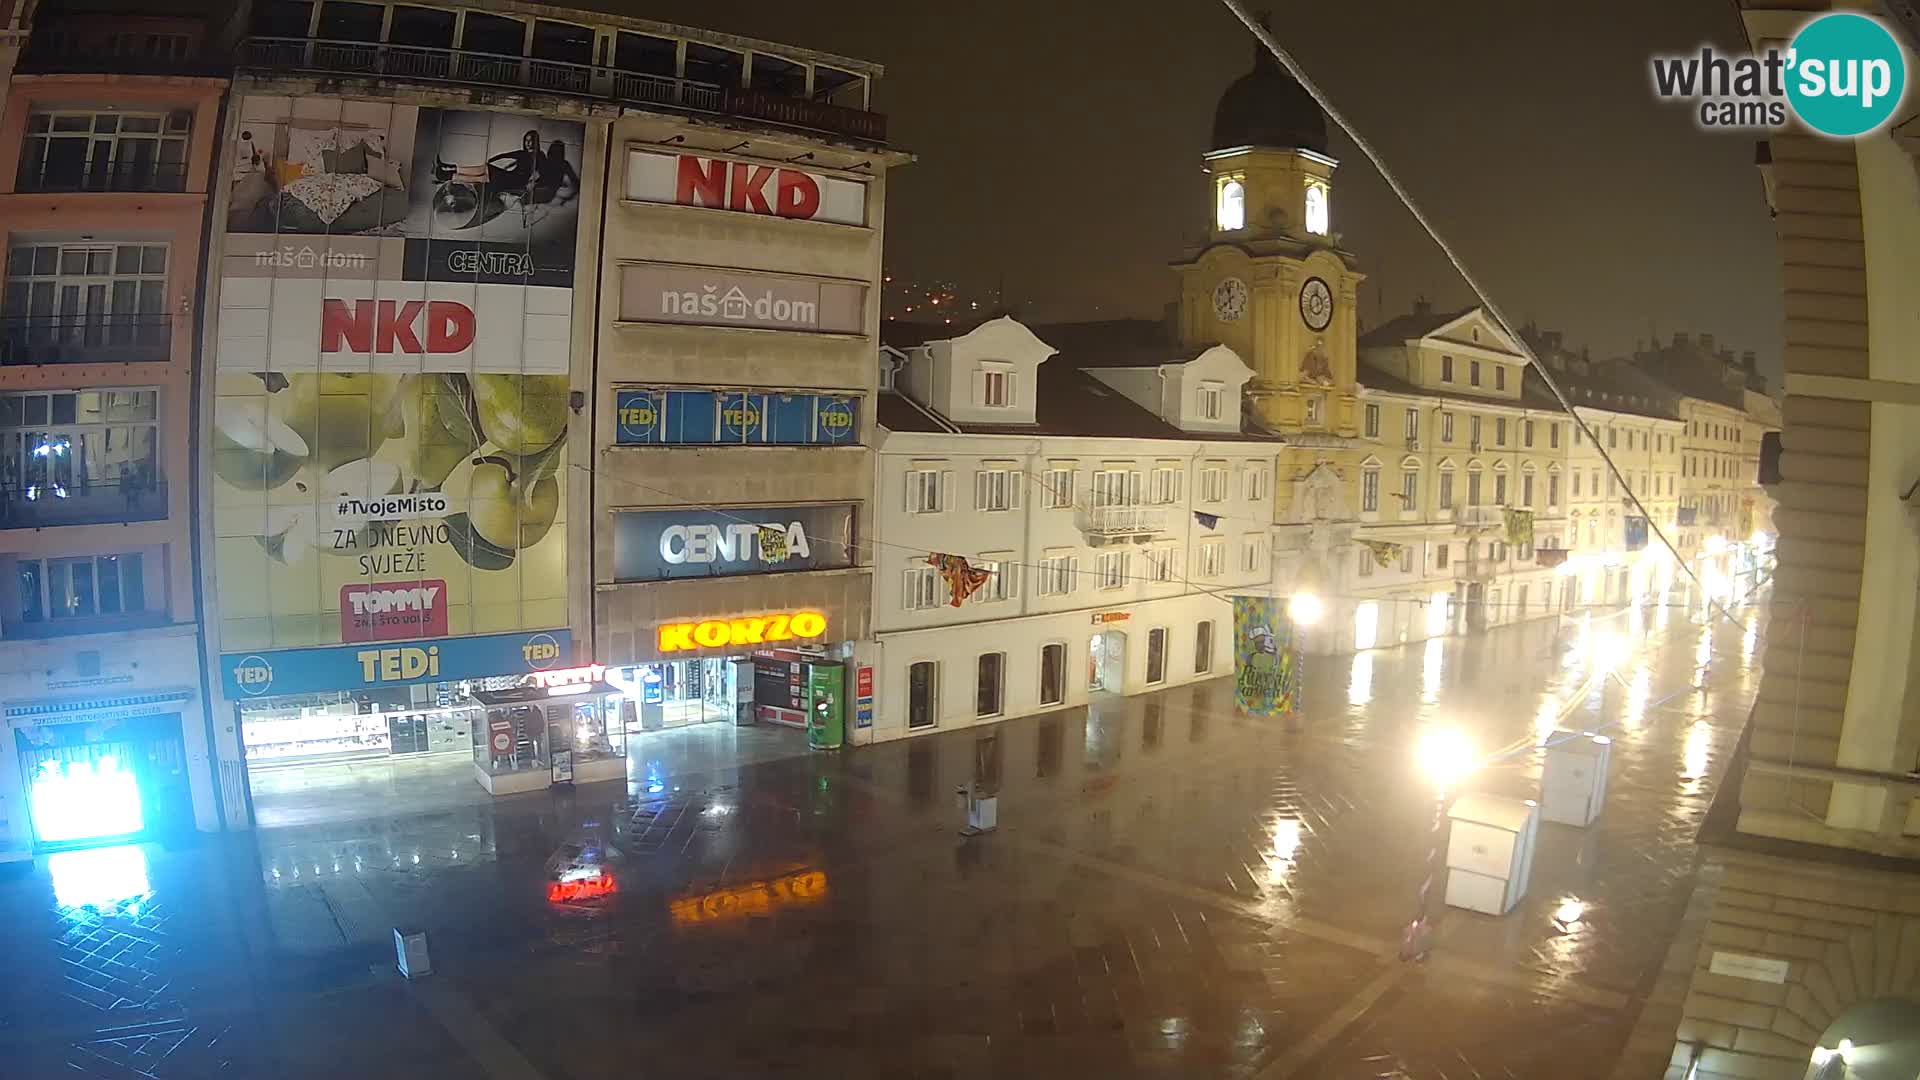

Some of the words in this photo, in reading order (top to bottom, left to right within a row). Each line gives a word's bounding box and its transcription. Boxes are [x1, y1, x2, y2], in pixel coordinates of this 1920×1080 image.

[676, 155, 820, 220] NKD
[255, 246, 295, 267] naš
[320, 248, 365, 269] dom
[448, 250, 534, 275] CENTRA
[662, 285, 718, 316] naš
[754, 290, 816, 323] dom
[321, 298, 477, 354] NKD
[619, 408, 657, 426] TEDi
[723, 409, 760, 427] TEDi
[338, 498, 446, 516] #TvojeMisto
[333, 529, 357, 549] ZA
[368, 525, 450, 548] DNEVNO
[660, 521, 810, 564] CENTA
[359, 547, 425, 575] SVJEŽE
[348, 587, 440, 615] TOMMY
[658, 612, 826, 651] KORZO
[358, 646, 439, 682] TEDi
[522, 643, 560, 660] TEDi
[234, 667, 272, 683] TEDi
[535, 663, 606, 689] TOMMY
